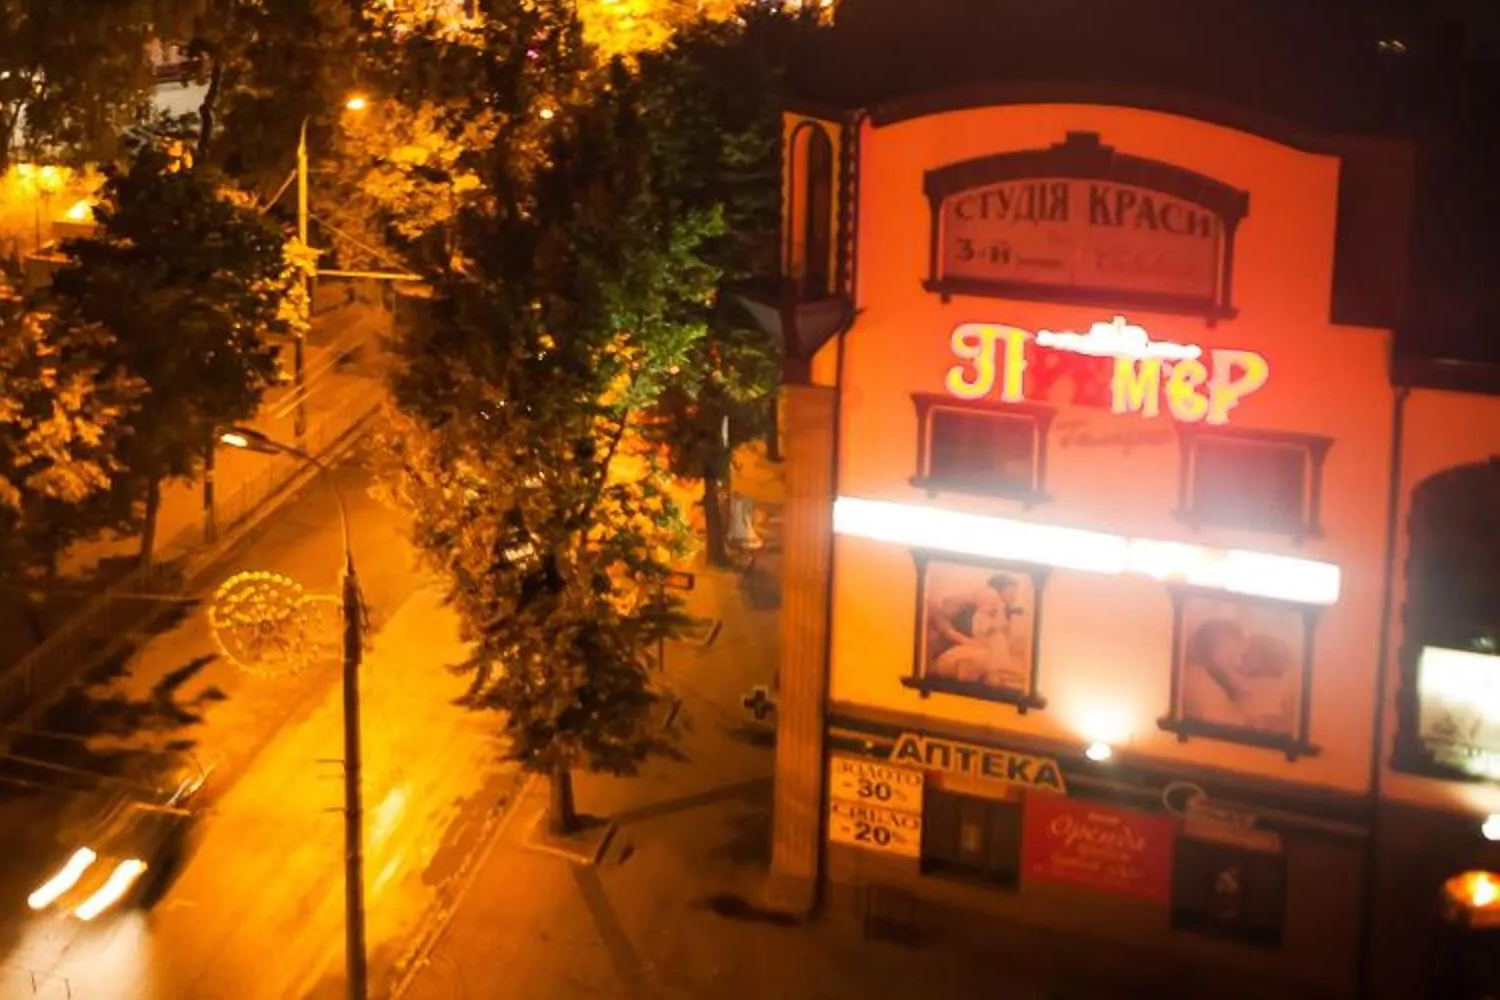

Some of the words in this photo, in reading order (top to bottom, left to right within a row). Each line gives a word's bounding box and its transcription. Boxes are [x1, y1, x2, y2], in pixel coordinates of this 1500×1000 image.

[953, 181, 1070, 226] СТУДІЯ
[1088, 182, 1215, 239] КРАСИ
[894, 733, 1063, 791] АПТЕКА
